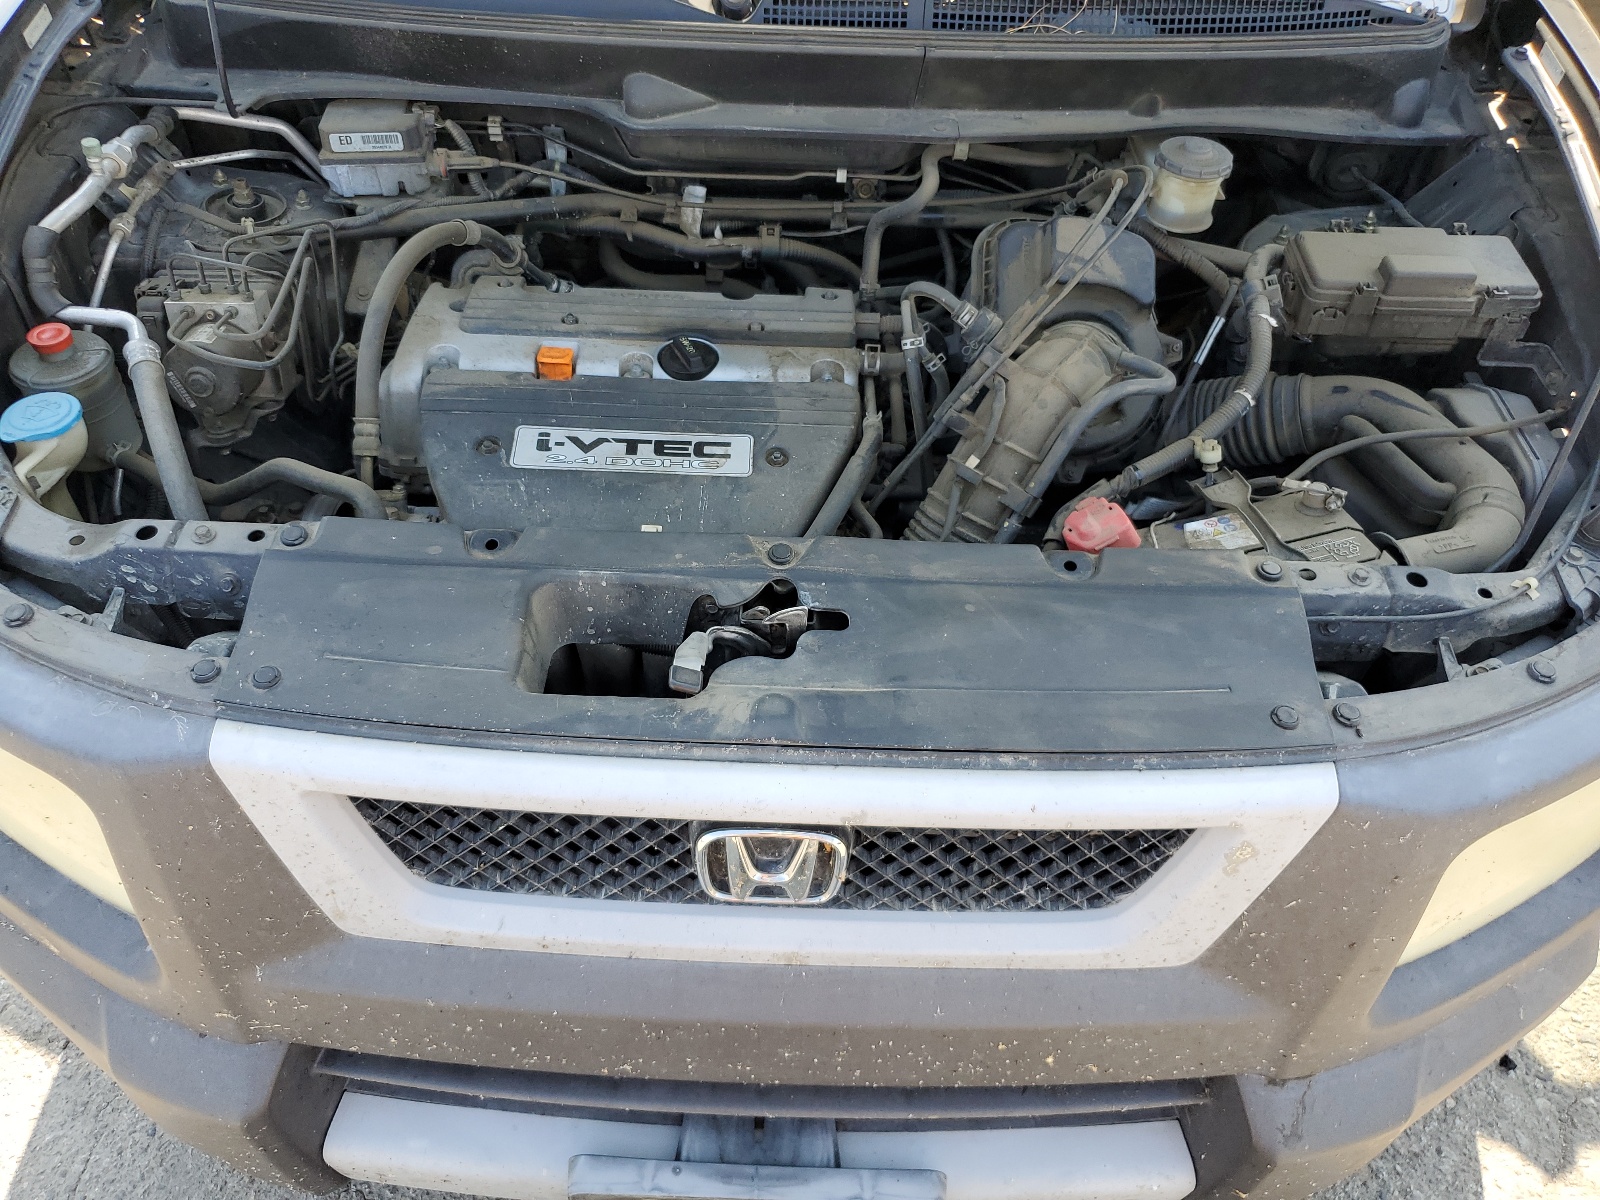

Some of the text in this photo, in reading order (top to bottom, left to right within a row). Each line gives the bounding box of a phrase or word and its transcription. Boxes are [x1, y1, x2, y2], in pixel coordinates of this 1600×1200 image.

[338, 135, 353, 146] ED
[535, 431, 732, 459] i-VTEC
[545, 454, 727, 470] 2.4 DOHC
